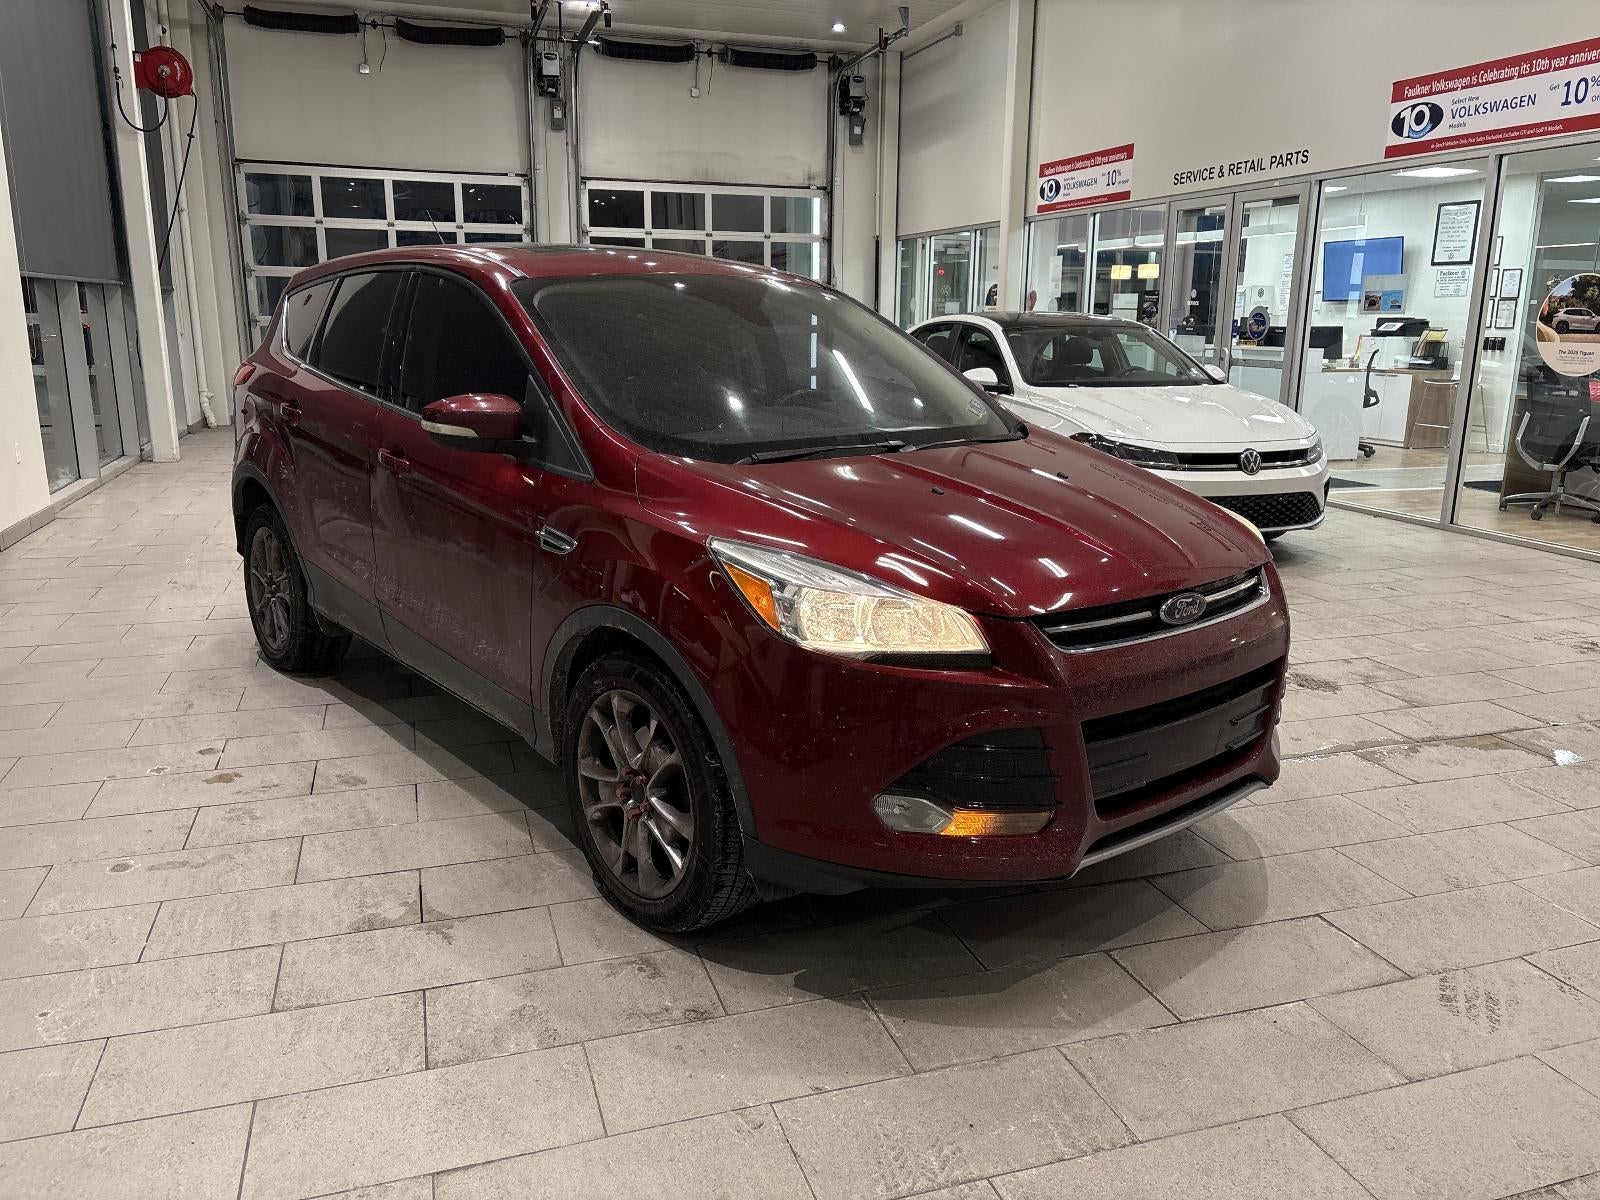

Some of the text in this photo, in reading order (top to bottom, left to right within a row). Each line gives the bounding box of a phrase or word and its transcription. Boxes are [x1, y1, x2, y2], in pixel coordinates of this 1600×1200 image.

[1404, 84, 1431, 98] Faulkner
[1432, 78, 1470, 91] Volkswagen
[1471, 72, 1478, 84] is
[1479, 65, 1519, 83] Celebrating
[1532, 57, 1549, 72] 10th
[1550, 56, 1568, 71] year
[1549, 83, 1560, 91] Get
[1451, 93, 1537, 119] VOLKSWAGEN
[1448, 121, 1467, 130] Models
[1173, 149, 1310, 186] SERVICE & RETAIL PARTS
[1063, 177, 1097, 190] VOLKSWAGEN
[1175, 597, 1200, 619] Ford
